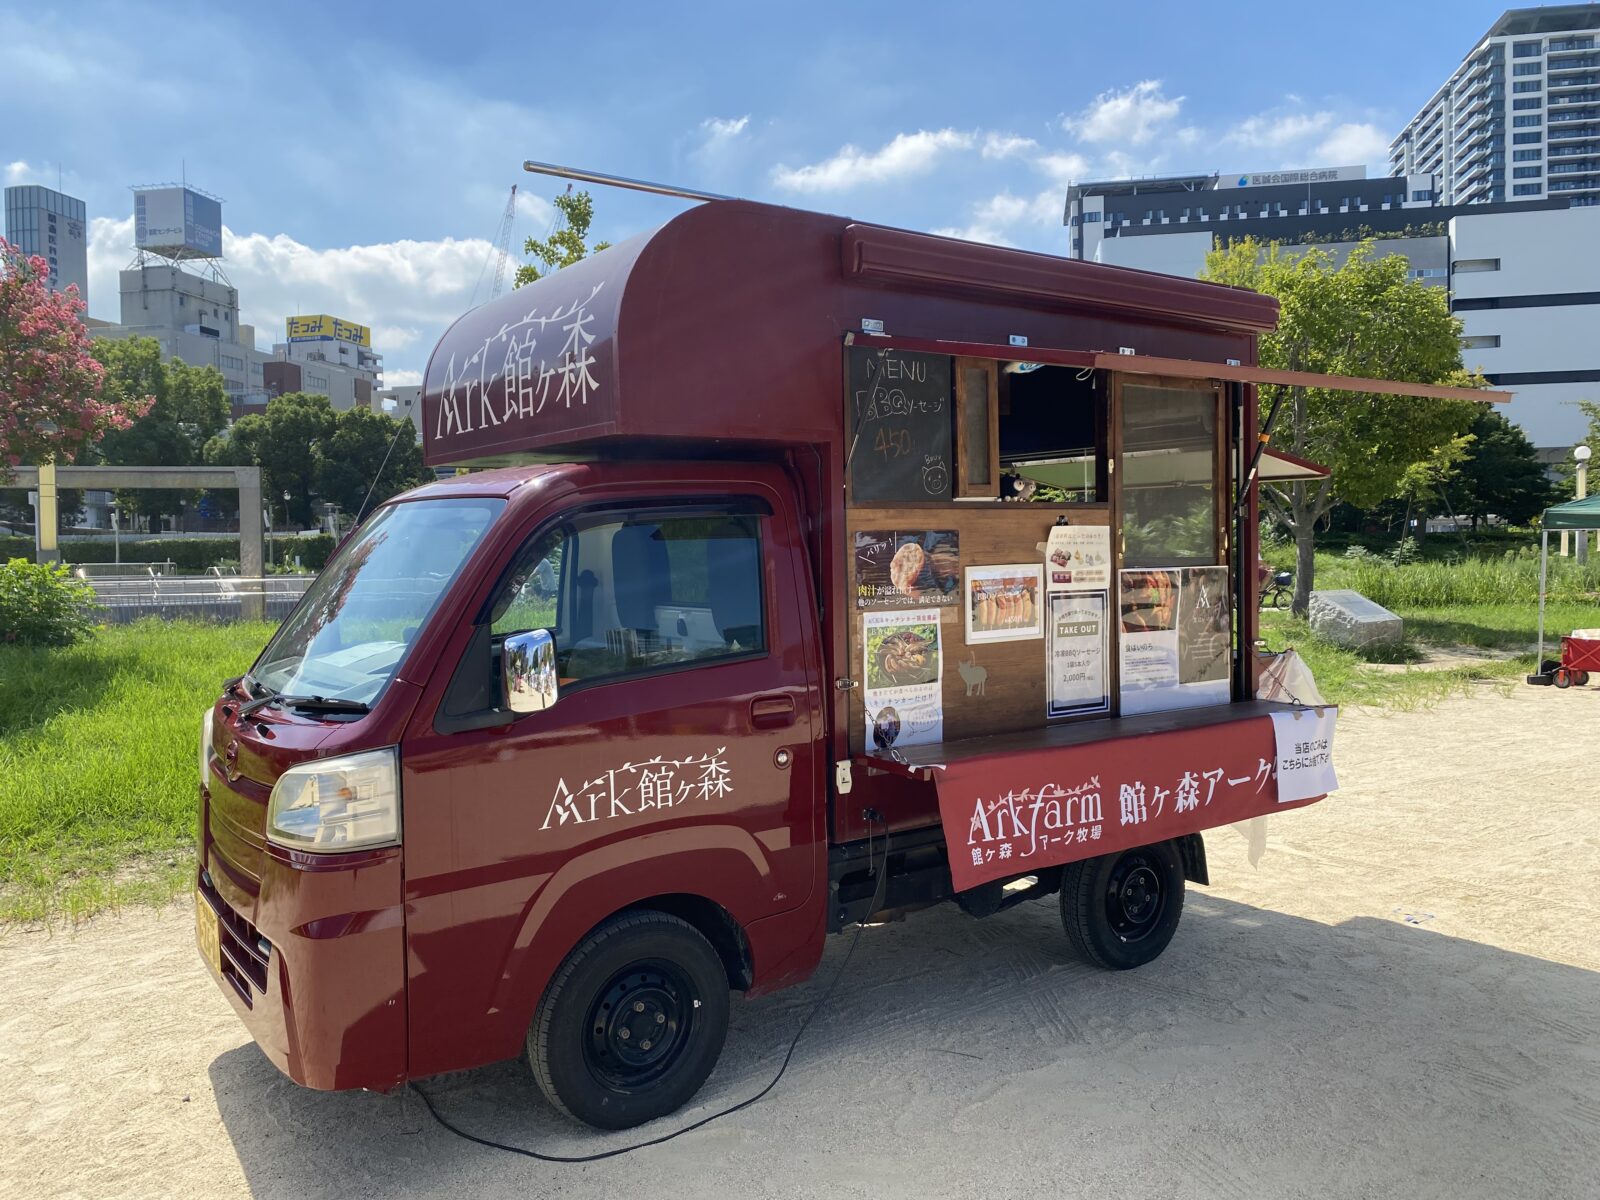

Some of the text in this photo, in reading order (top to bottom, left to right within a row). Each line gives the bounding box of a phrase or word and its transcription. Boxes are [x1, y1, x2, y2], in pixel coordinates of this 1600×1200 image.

[1252, 170, 1338, 185] 医誠会国際総合病院
[288, 317, 323, 338] たつみ
[333, 319, 363, 343] たつみ
[866, 357, 926, 382] MENU
[1059, 624, 1096, 635] TAKE OUT
[1054, 647, 1101, 658] 冷凍BBQソーセージ
[1063, 672, 1086, 683] 2,000円
[1039, 824, 1102, 851] アーク牧場
